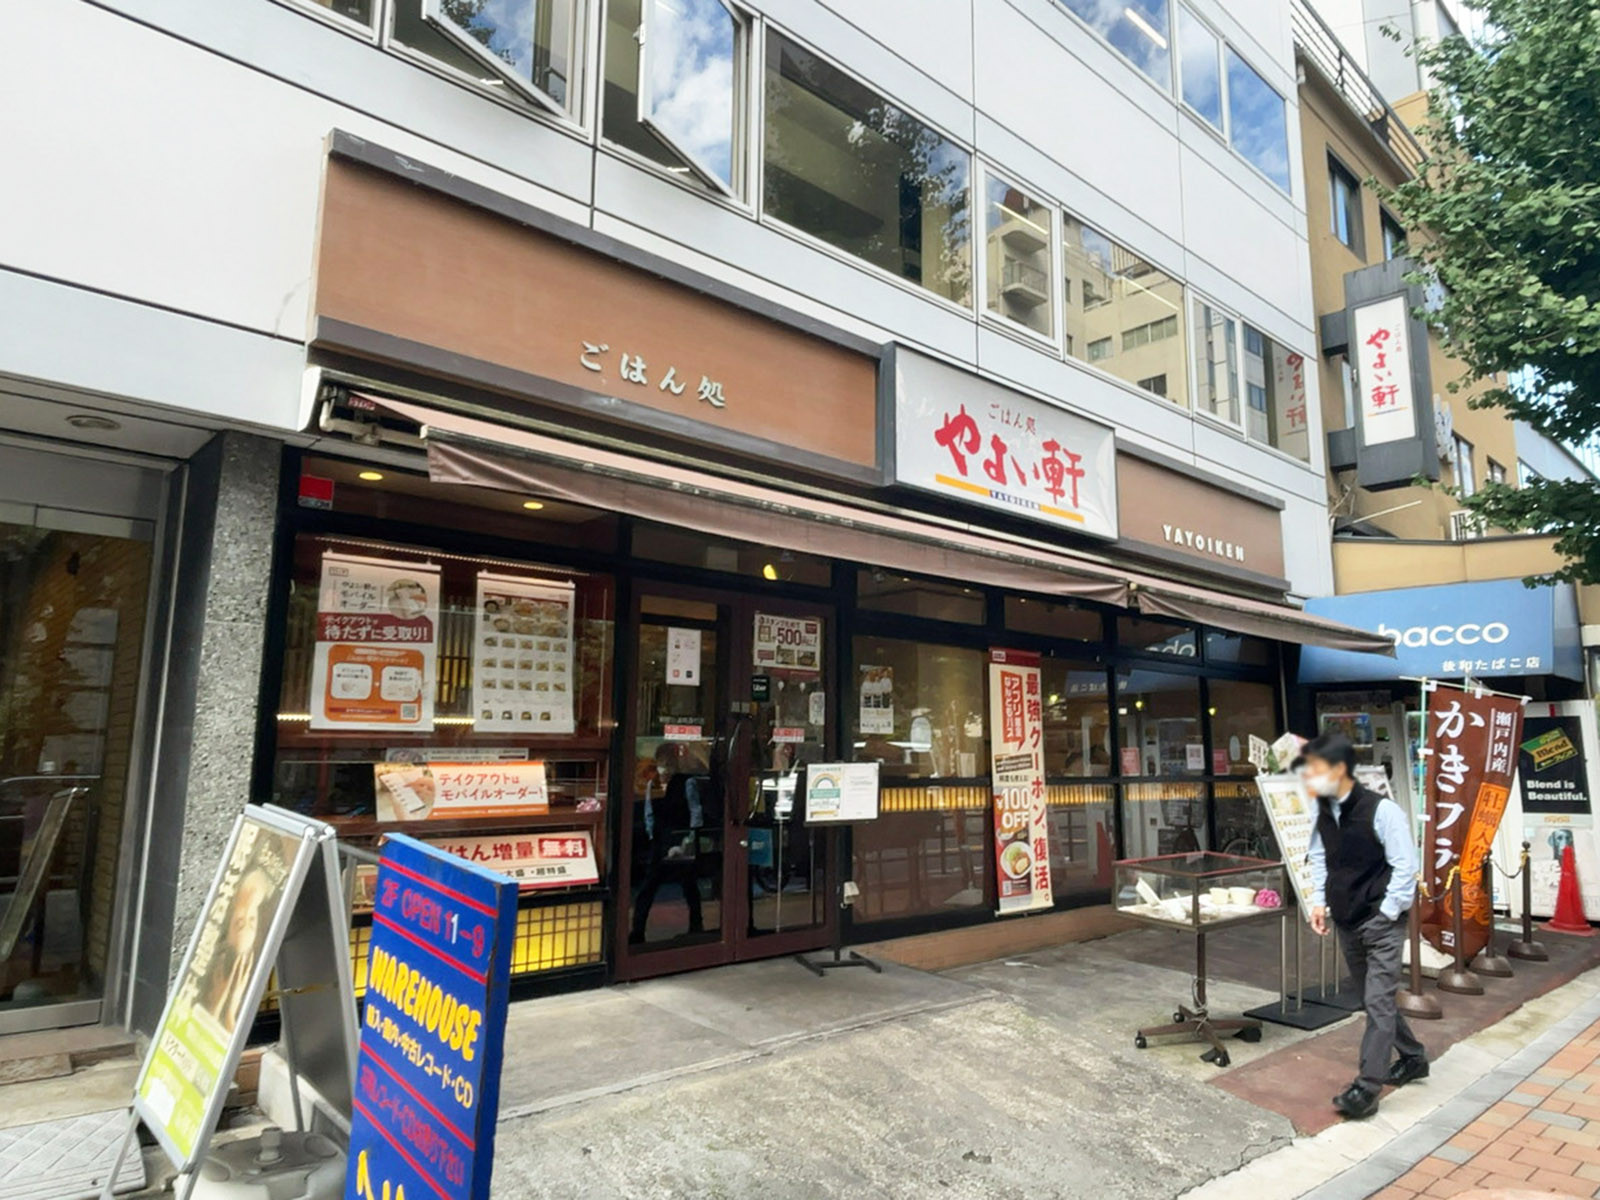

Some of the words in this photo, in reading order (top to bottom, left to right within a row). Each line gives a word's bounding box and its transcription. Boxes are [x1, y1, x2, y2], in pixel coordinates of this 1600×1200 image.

[580, 340, 726, 408] ごはん処
[1366, 327, 1400, 408] やよい軒
[988, 403, 1037, 435] ごはん処
[934, 403, 1085, 508] やよい軒
[1163, 524, 1245, 562] YAYOIKEN
[777, 627, 801, 646] 500
[1491, 710, 1512, 773] 瀬戸内産
[439, 773, 520, 786] テイクアウトは
[1526, 780, 1562, 789] Blend
[1564, 780, 1576, 789] is
[1528, 791, 1588, 801] Beautiful.
[1001, 811, 1029, 829] OFF
[541, 840, 585, 858] 無料
[401, 888, 442, 936] OPEN
[369, 945, 482, 1062] WAREHOUSE
